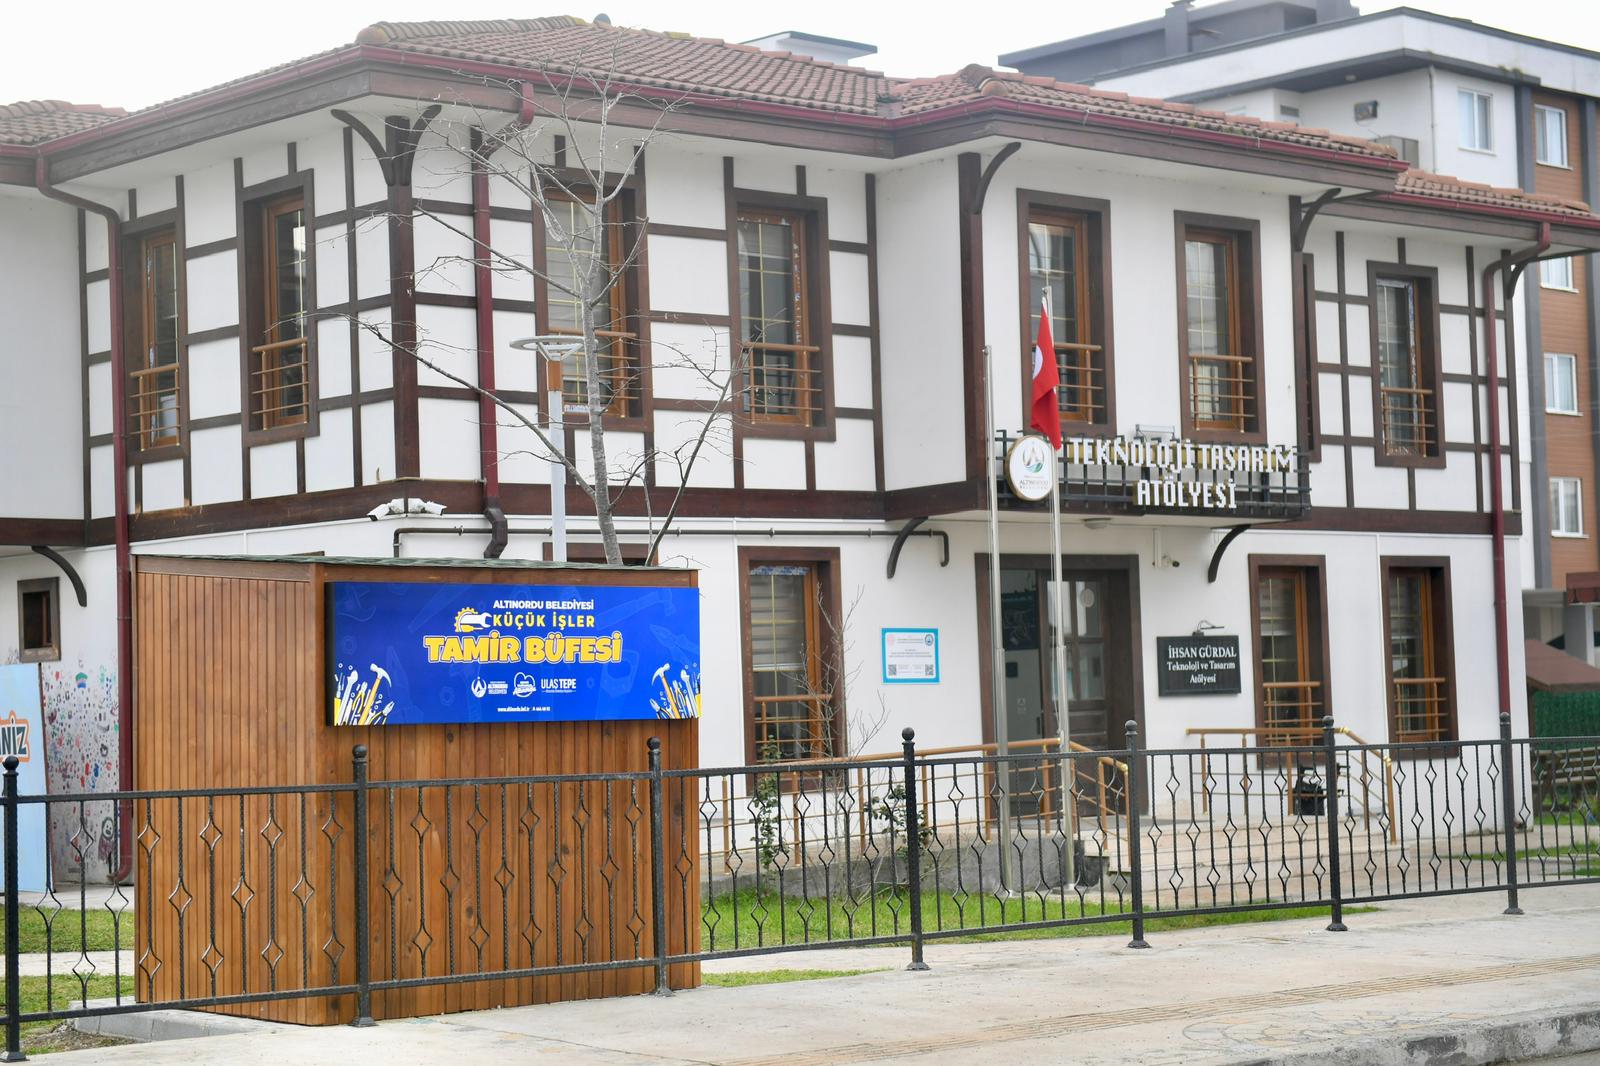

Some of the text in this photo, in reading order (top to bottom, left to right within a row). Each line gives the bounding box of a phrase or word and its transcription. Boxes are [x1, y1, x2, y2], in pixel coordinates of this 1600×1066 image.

[1069, 437, 1295, 474] TEKNOLOJİ TASARIM
[1137, 475, 1237, 509] ATÖLYESİ
[493, 599, 595, 610] ALTINORDU BELEDİYESİ
[493, 611, 595, 631] KÜÇÜK İŞLER
[423, 630, 623, 665] TAMİR BÜFESİ
[1168, 644, 1237, 659] İHSAN GÜRDAL
[1166, 660, 1200, 672] Teknoloji
[1209, 660, 1236, 670] Tasarım
[559, 678, 577, 689] TEPE
[1189, 673, 1216, 685] Atölyesi
[0, 717, 27, 755] NİZ
